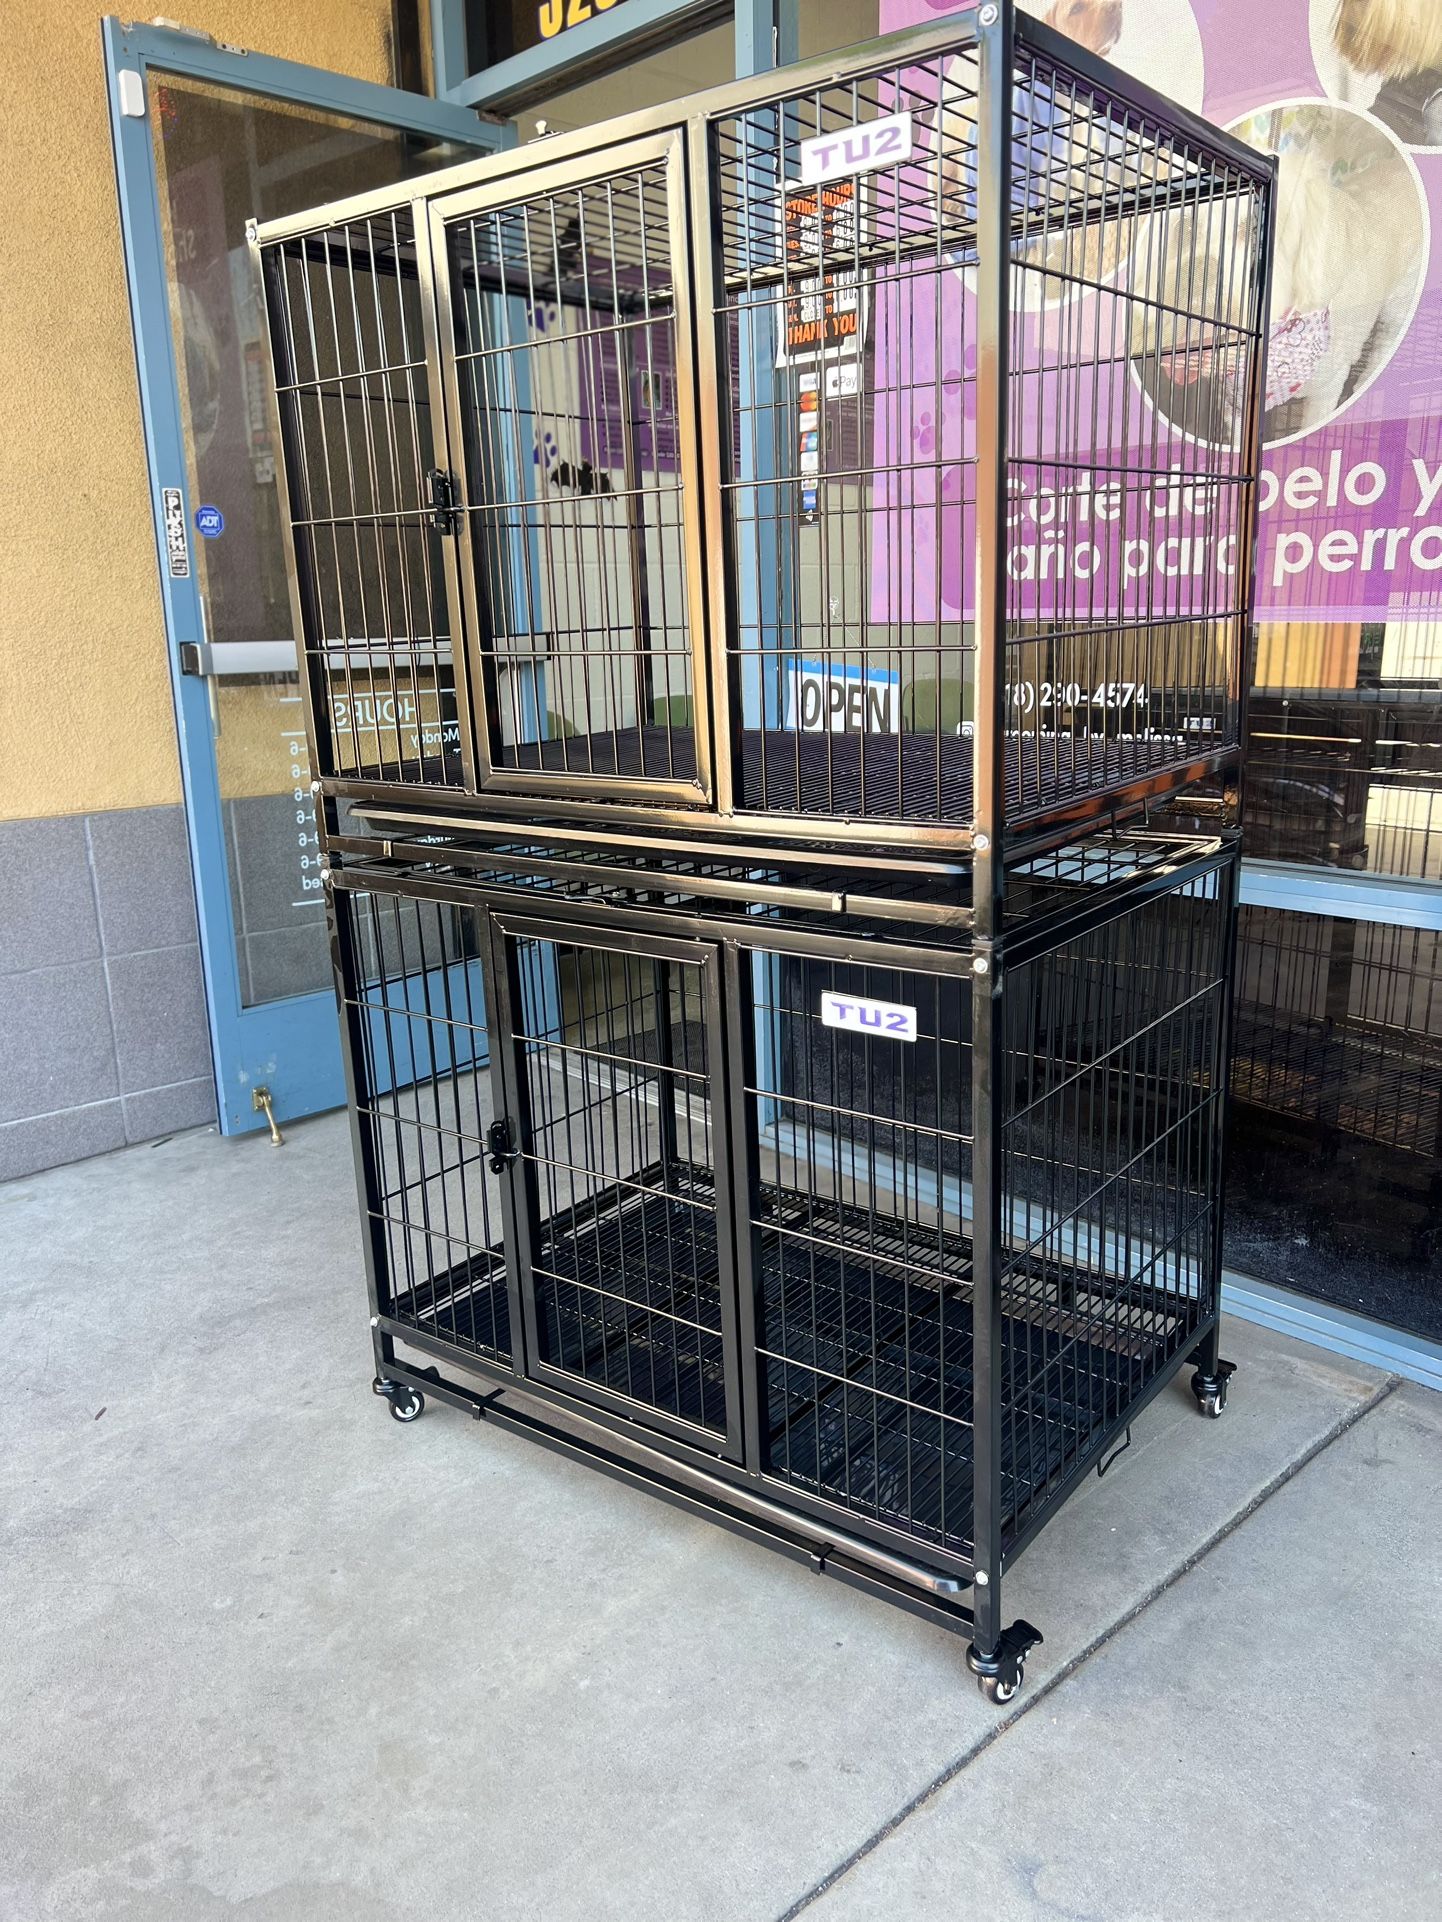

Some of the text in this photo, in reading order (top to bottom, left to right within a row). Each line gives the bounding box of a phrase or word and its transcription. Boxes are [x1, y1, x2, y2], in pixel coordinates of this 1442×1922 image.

[811, 126, 902, 171] TU2
[832, 312, 857, 336] YOU
[200, 515, 219, 528] ADT
[1006, 529, 1101, 581] año
[802, 678, 889, 734] OPEN
[831, 1001, 908, 1032] TU2
